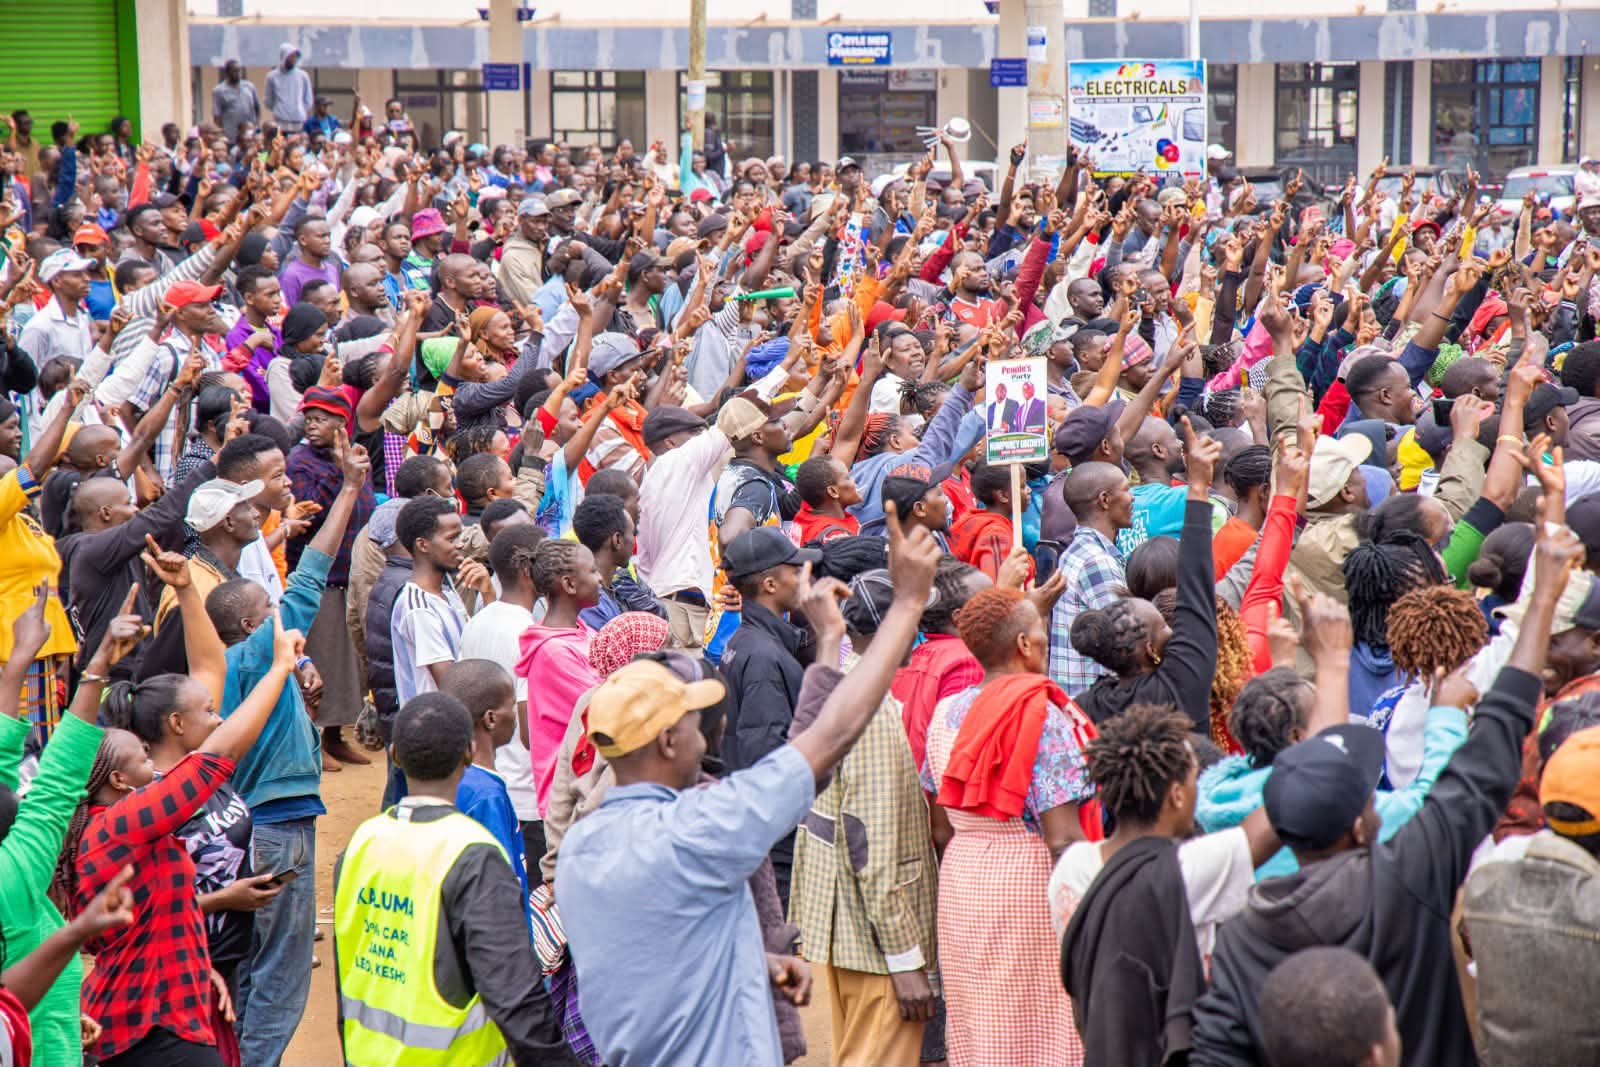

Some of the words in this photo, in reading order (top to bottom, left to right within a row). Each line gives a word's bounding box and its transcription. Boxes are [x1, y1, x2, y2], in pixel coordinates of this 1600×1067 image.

[829, 47, 888, 58] PHARMACY
[1086, 80, 1187, 96] ELECTRICALS
[1011, 373, 1031, 381] Party
